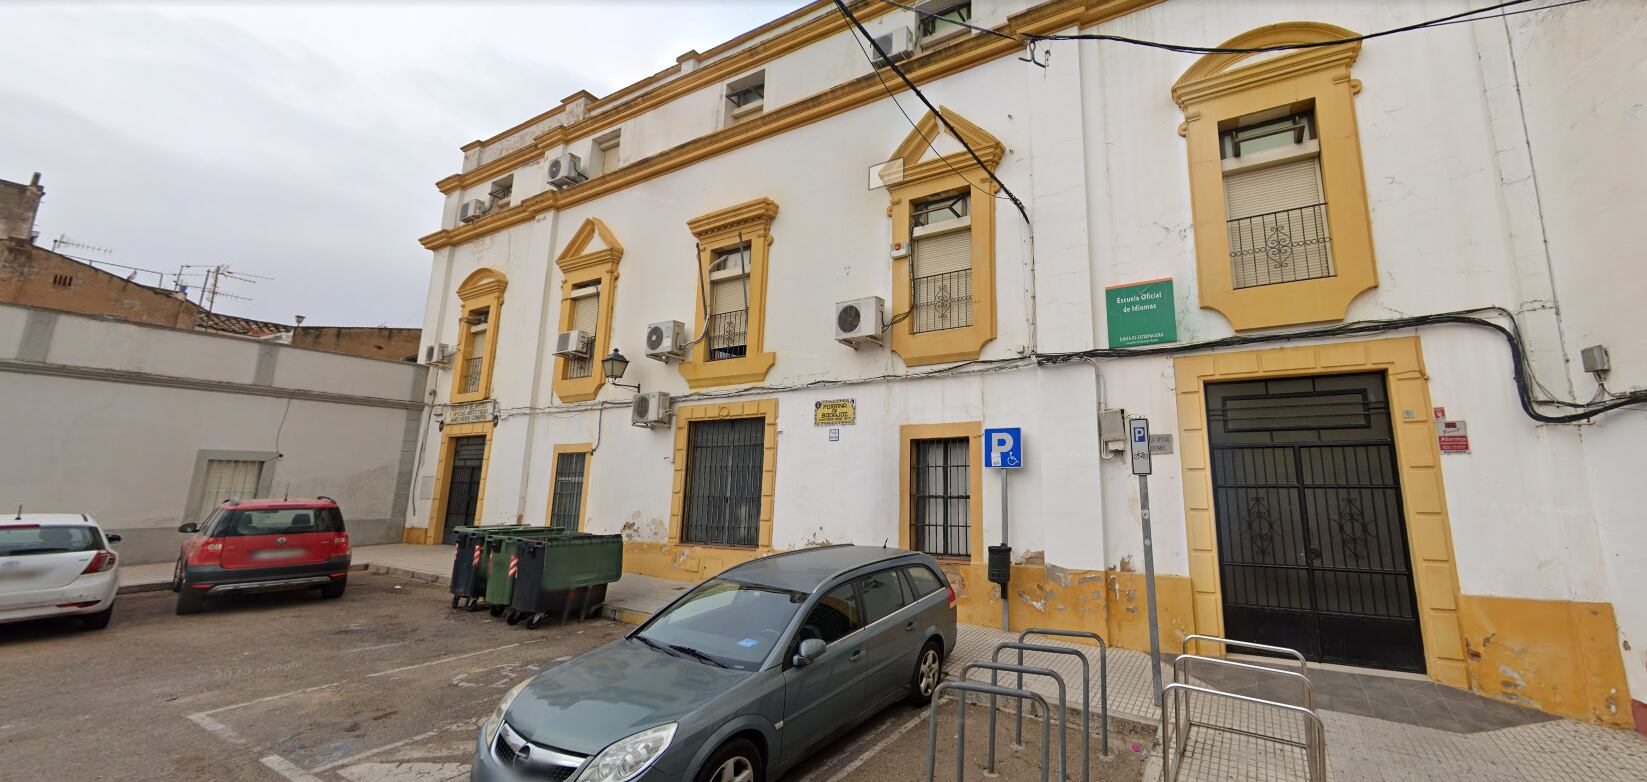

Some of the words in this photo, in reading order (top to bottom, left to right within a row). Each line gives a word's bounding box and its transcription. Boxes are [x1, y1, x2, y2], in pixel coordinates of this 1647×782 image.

[1116, 295, 1140, 304] Escuela
[1140, 292, 1162, 301] Oficial
[1131, 303, 1157, 312] Idiomas
[821, 411, 848, 419] BADAJOZ
[1135, 429, 1144, 441] P
[991, 432, 1013, 464] P
